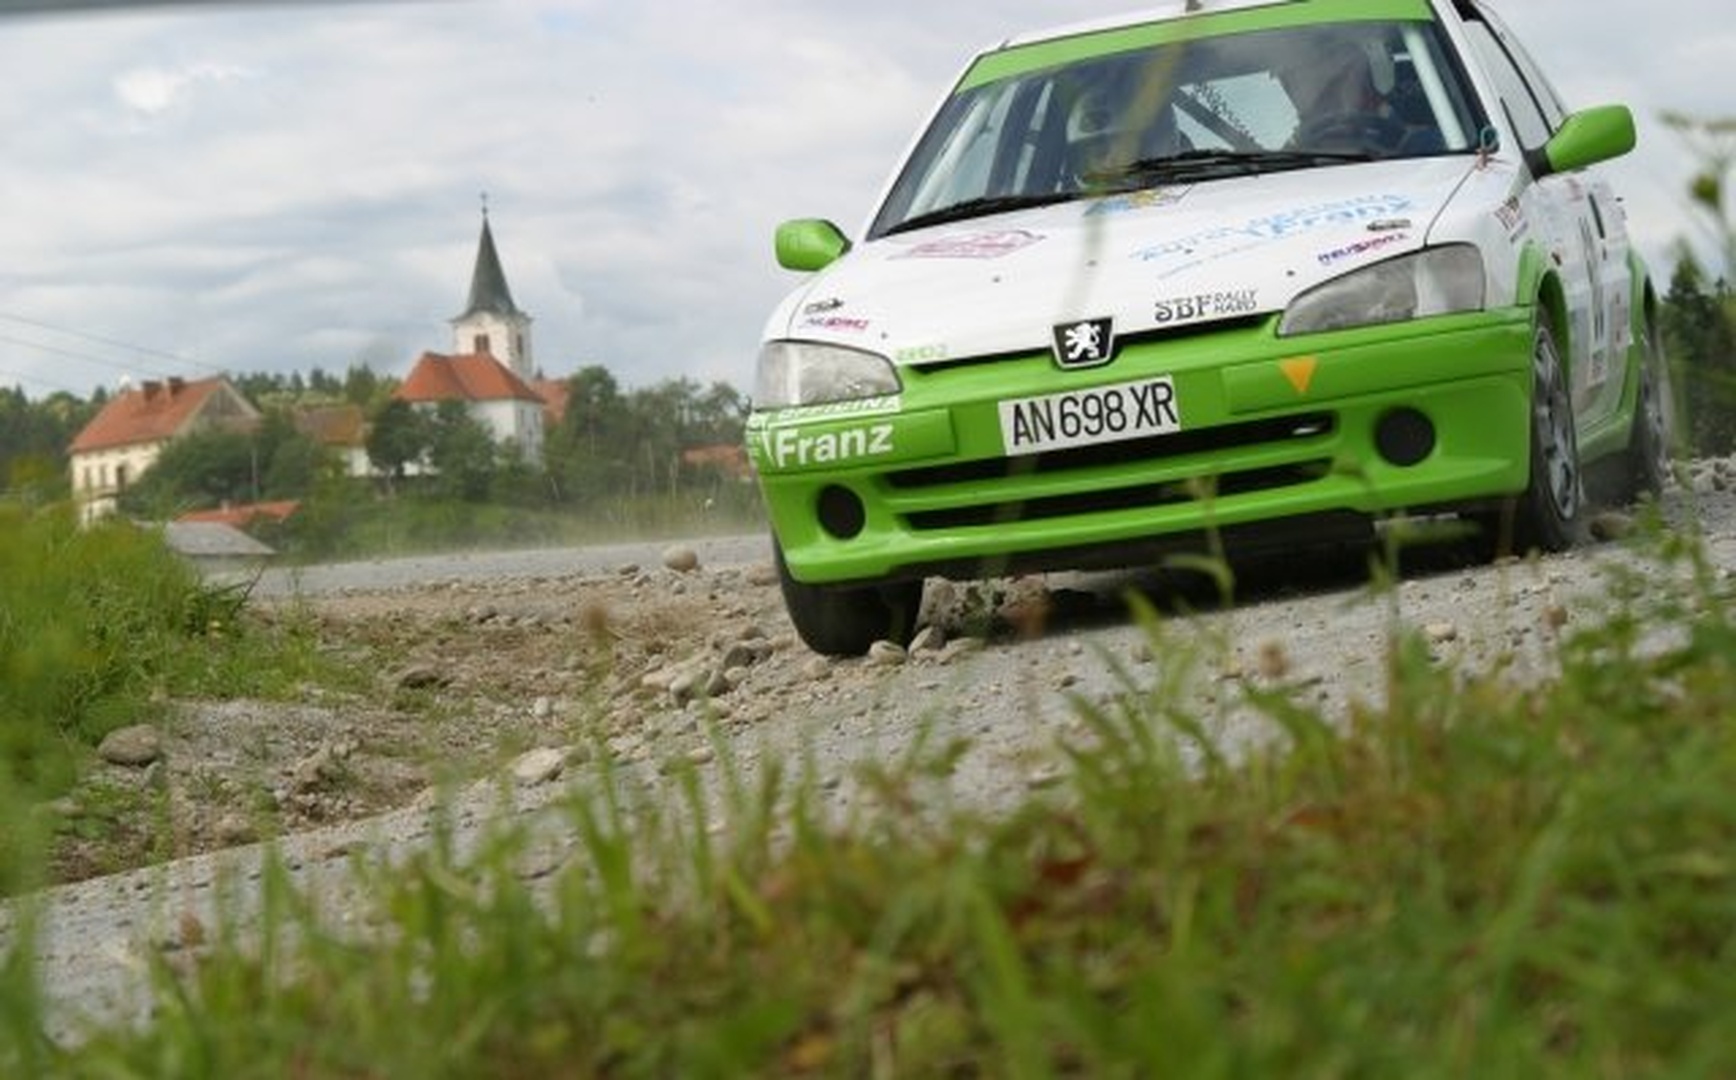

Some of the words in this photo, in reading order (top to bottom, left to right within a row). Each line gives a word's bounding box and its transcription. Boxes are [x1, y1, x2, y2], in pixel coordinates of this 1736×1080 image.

[1154, 293, 1212, 323] SBF
[1013, 398, 1056, 446] AN
[1059, 389, 1128, 438] 698
[1128, 381, 1178, 430] XR
[775, 424, 894, 468] Franz
